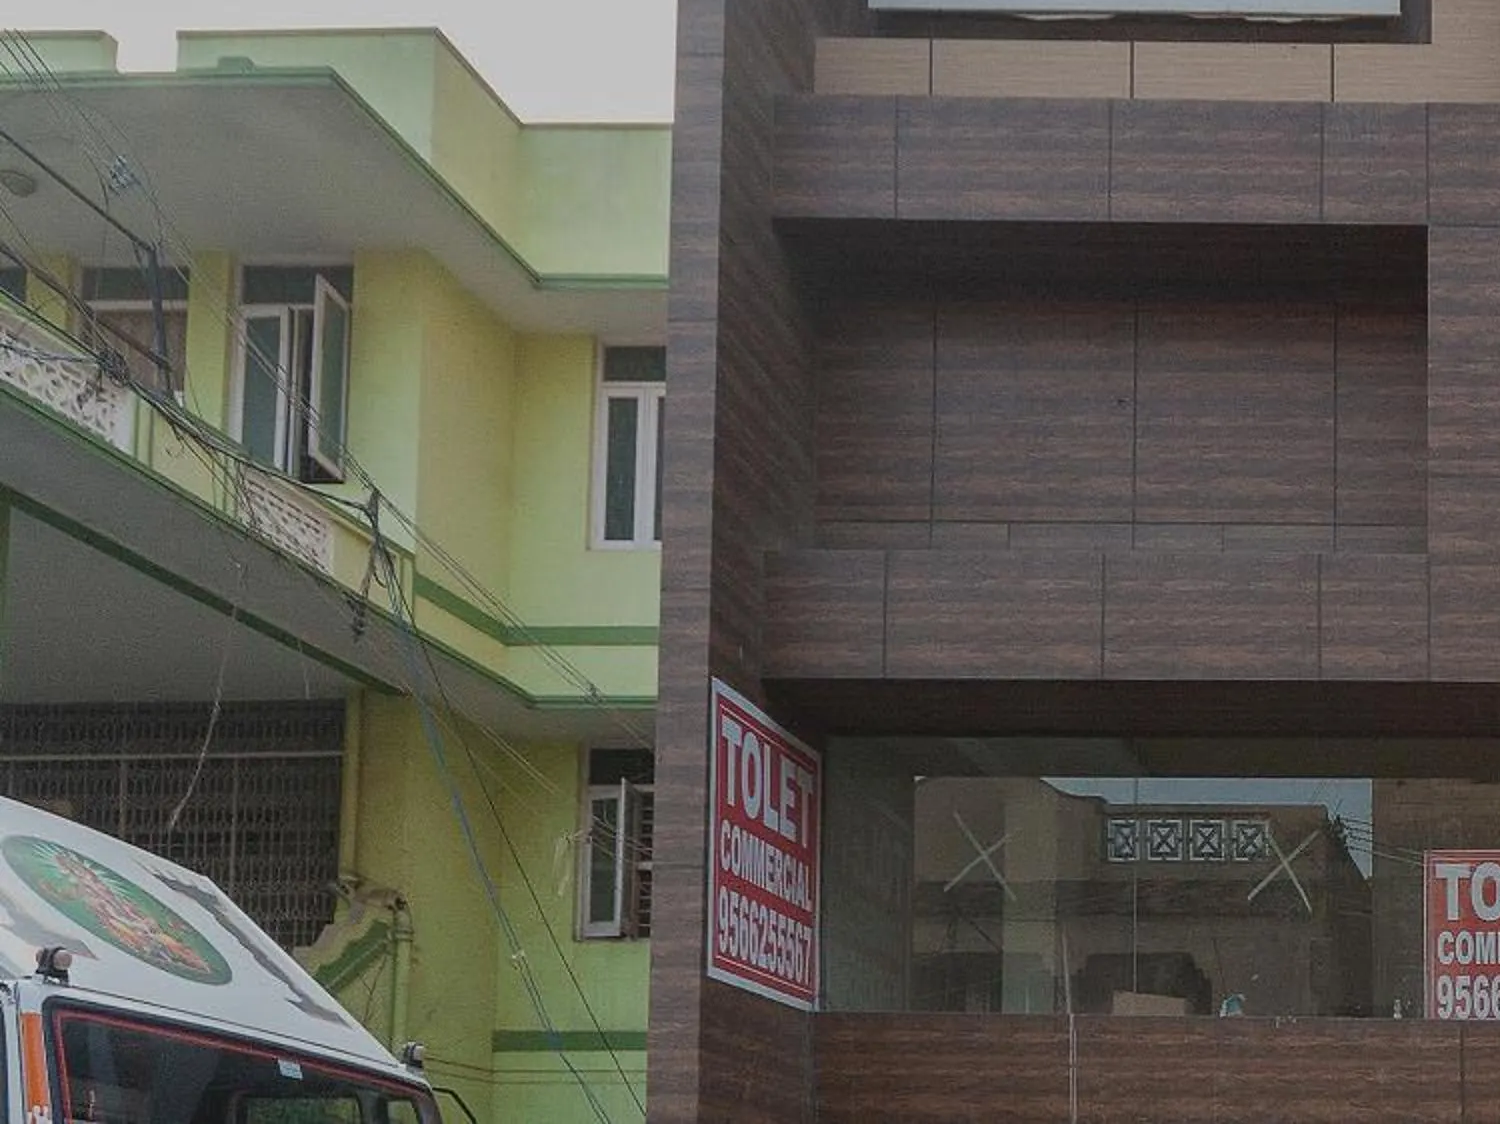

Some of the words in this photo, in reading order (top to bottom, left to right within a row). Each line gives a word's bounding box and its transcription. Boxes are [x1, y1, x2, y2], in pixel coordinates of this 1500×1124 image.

[721, 714, 814, 849] TOLET
[719, 818, 812, 912] COMMERCIAL
[718, 884, 813, 986] 9566255567
